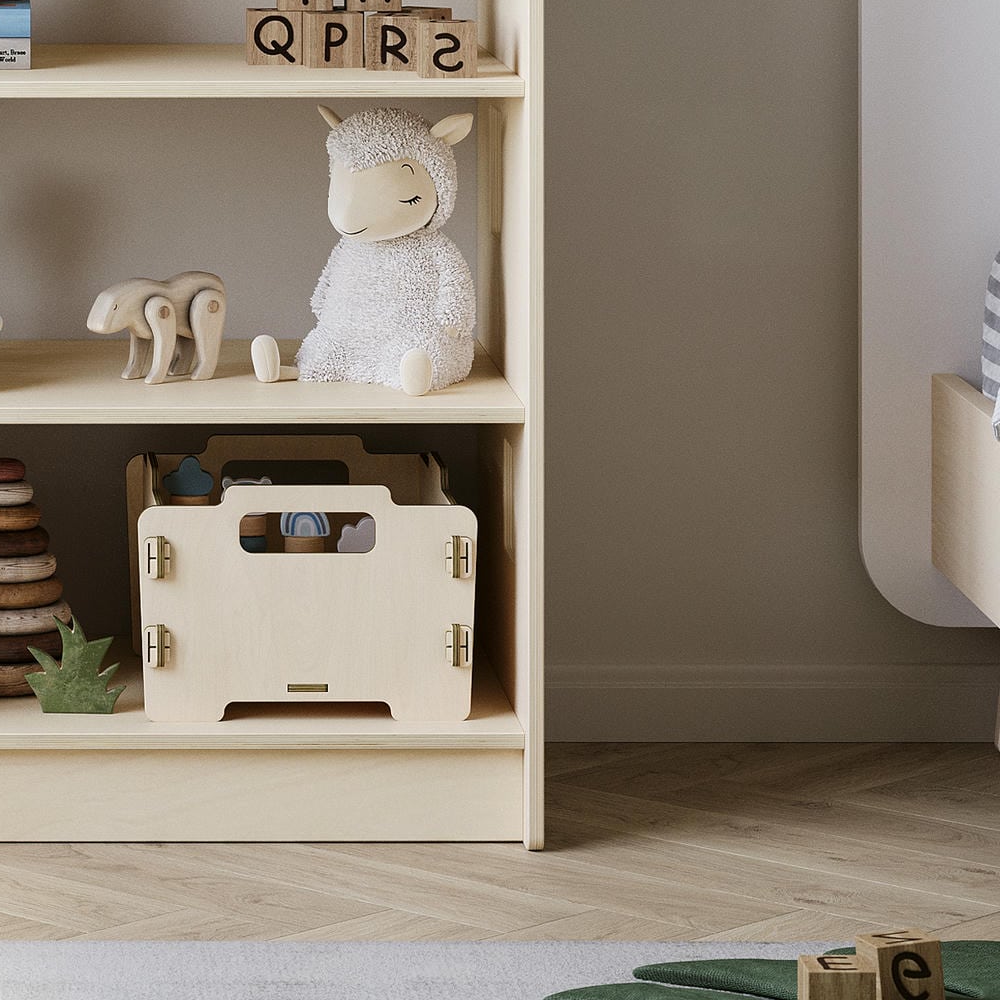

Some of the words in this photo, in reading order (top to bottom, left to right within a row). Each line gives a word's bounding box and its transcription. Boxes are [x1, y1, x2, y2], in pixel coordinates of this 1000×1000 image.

[254, 15, 296, 63] Q
[324, 22, 348, 63] P
[381, 24, 409, 65] R
[816, 956, 858, 971] E
[891, 951, 932, 1000] e
